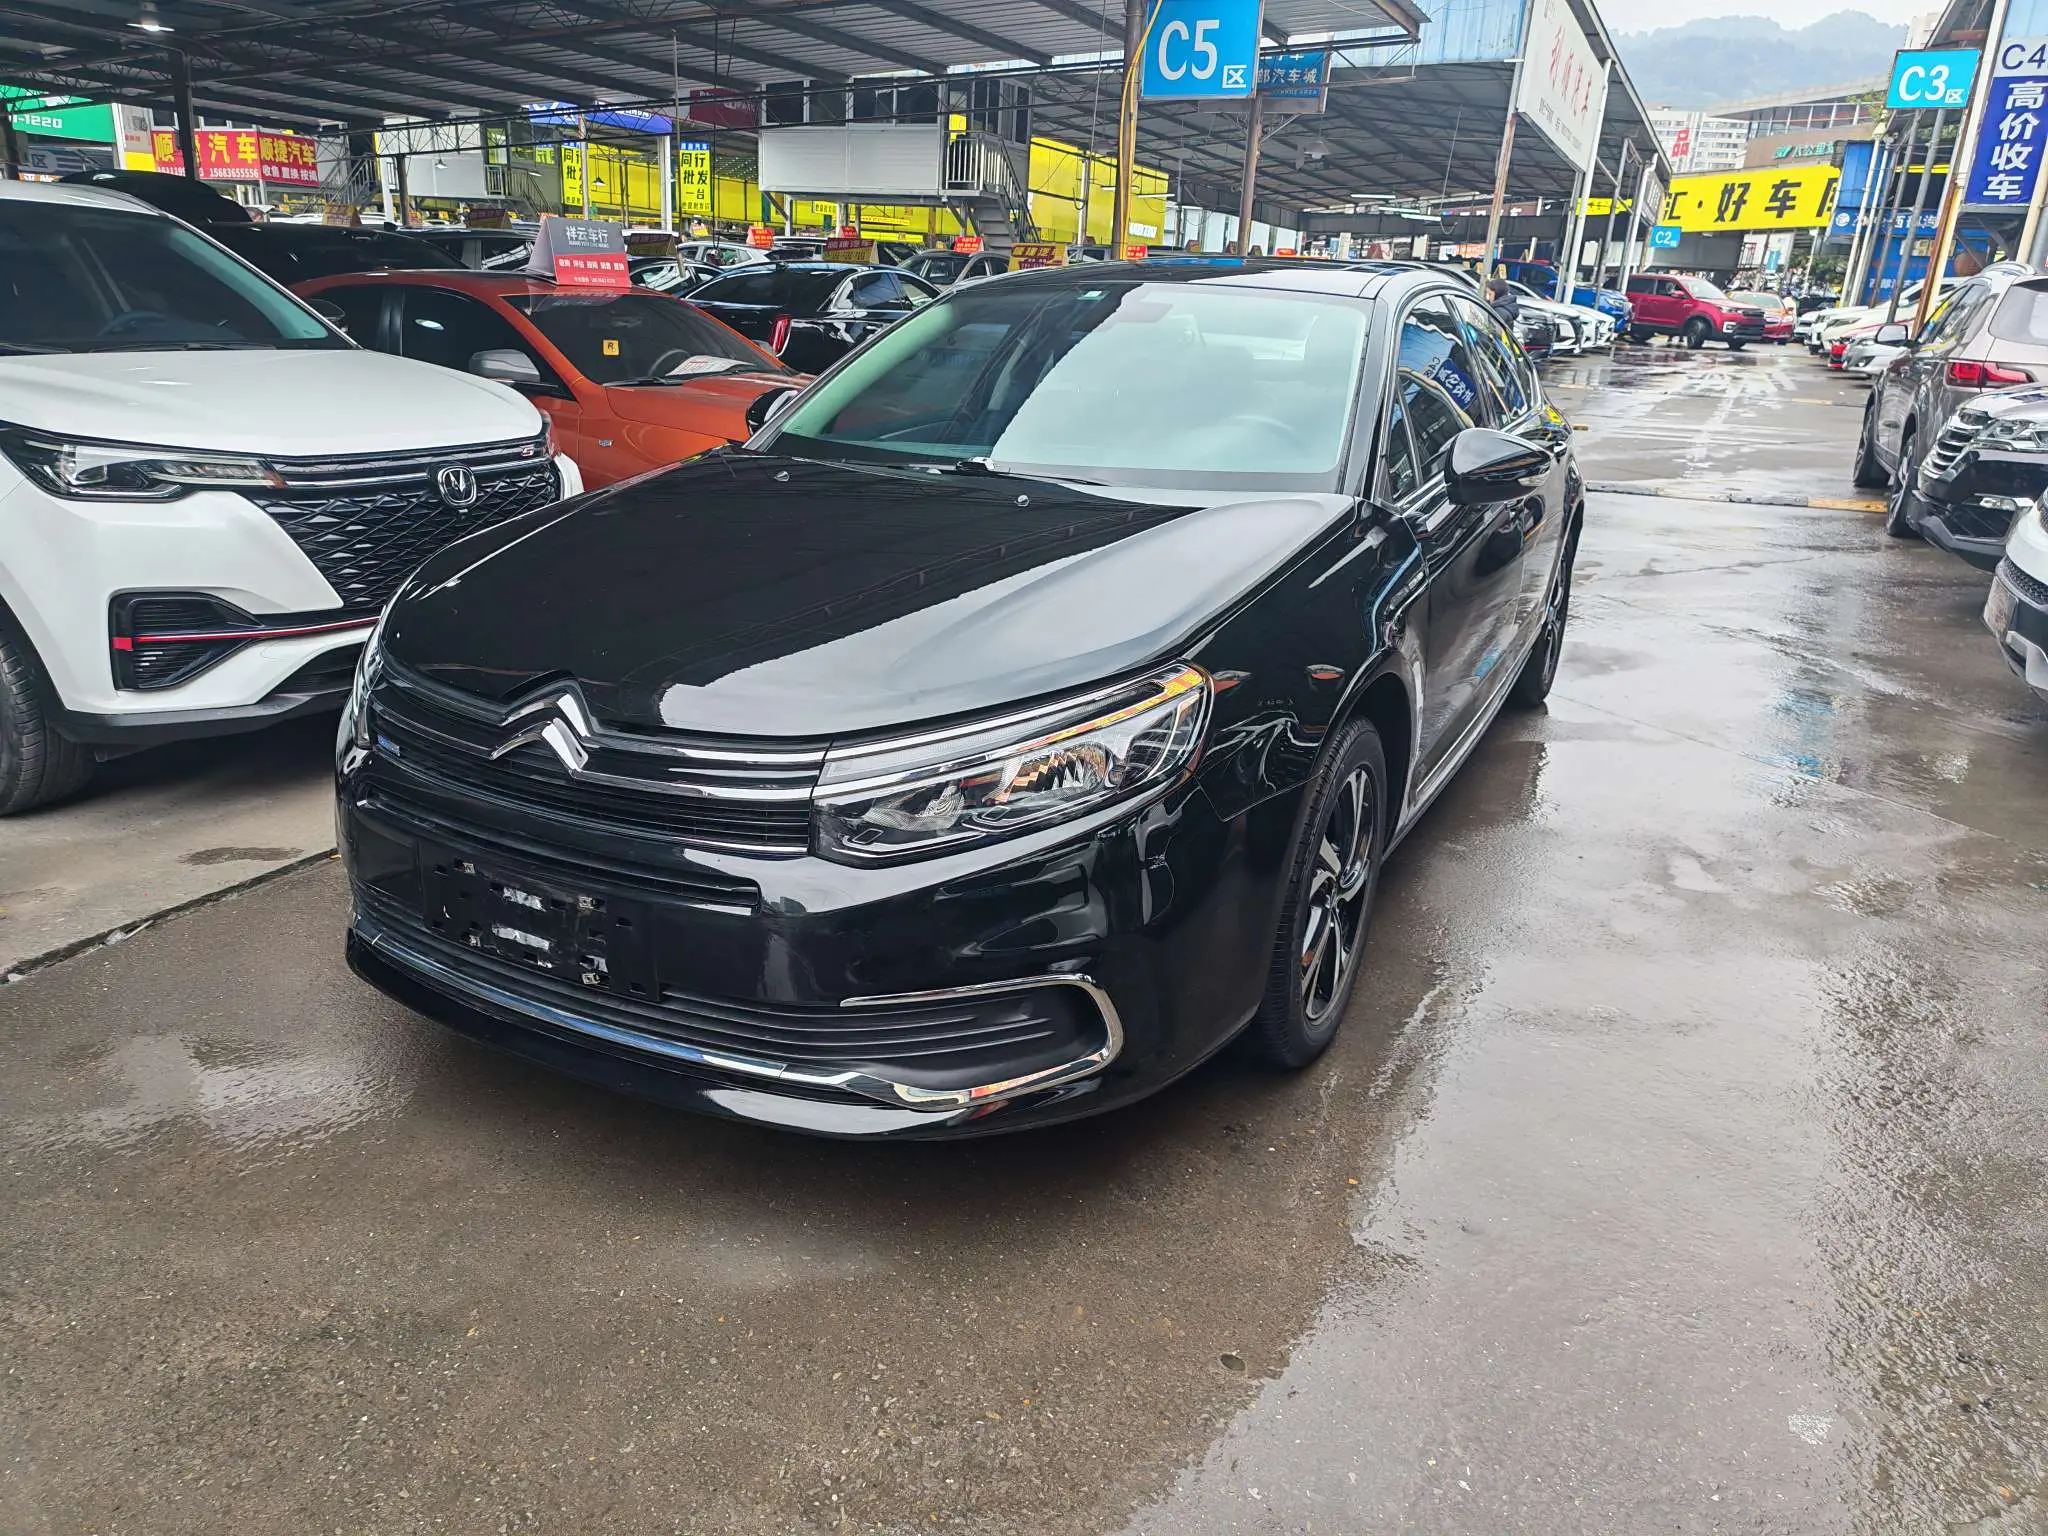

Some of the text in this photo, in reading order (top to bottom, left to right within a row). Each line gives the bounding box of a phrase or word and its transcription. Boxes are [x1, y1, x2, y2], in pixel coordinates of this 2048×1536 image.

[1158, 19, 1248, 89] C5区
[1898, 64, 1965, 104] C3区
[152, 132, 258, 166] 顺汽车
[260, 137, 316, 167] 顺捷汽车
[1982, 80, 2048, 201] 高价收车
[209, 167, 259, 178] 15683655556
[681, 153, 706, 168] 同行
[683, 170, 708, 185] 批发
[566, 225, 609, 243] 祥云车行
